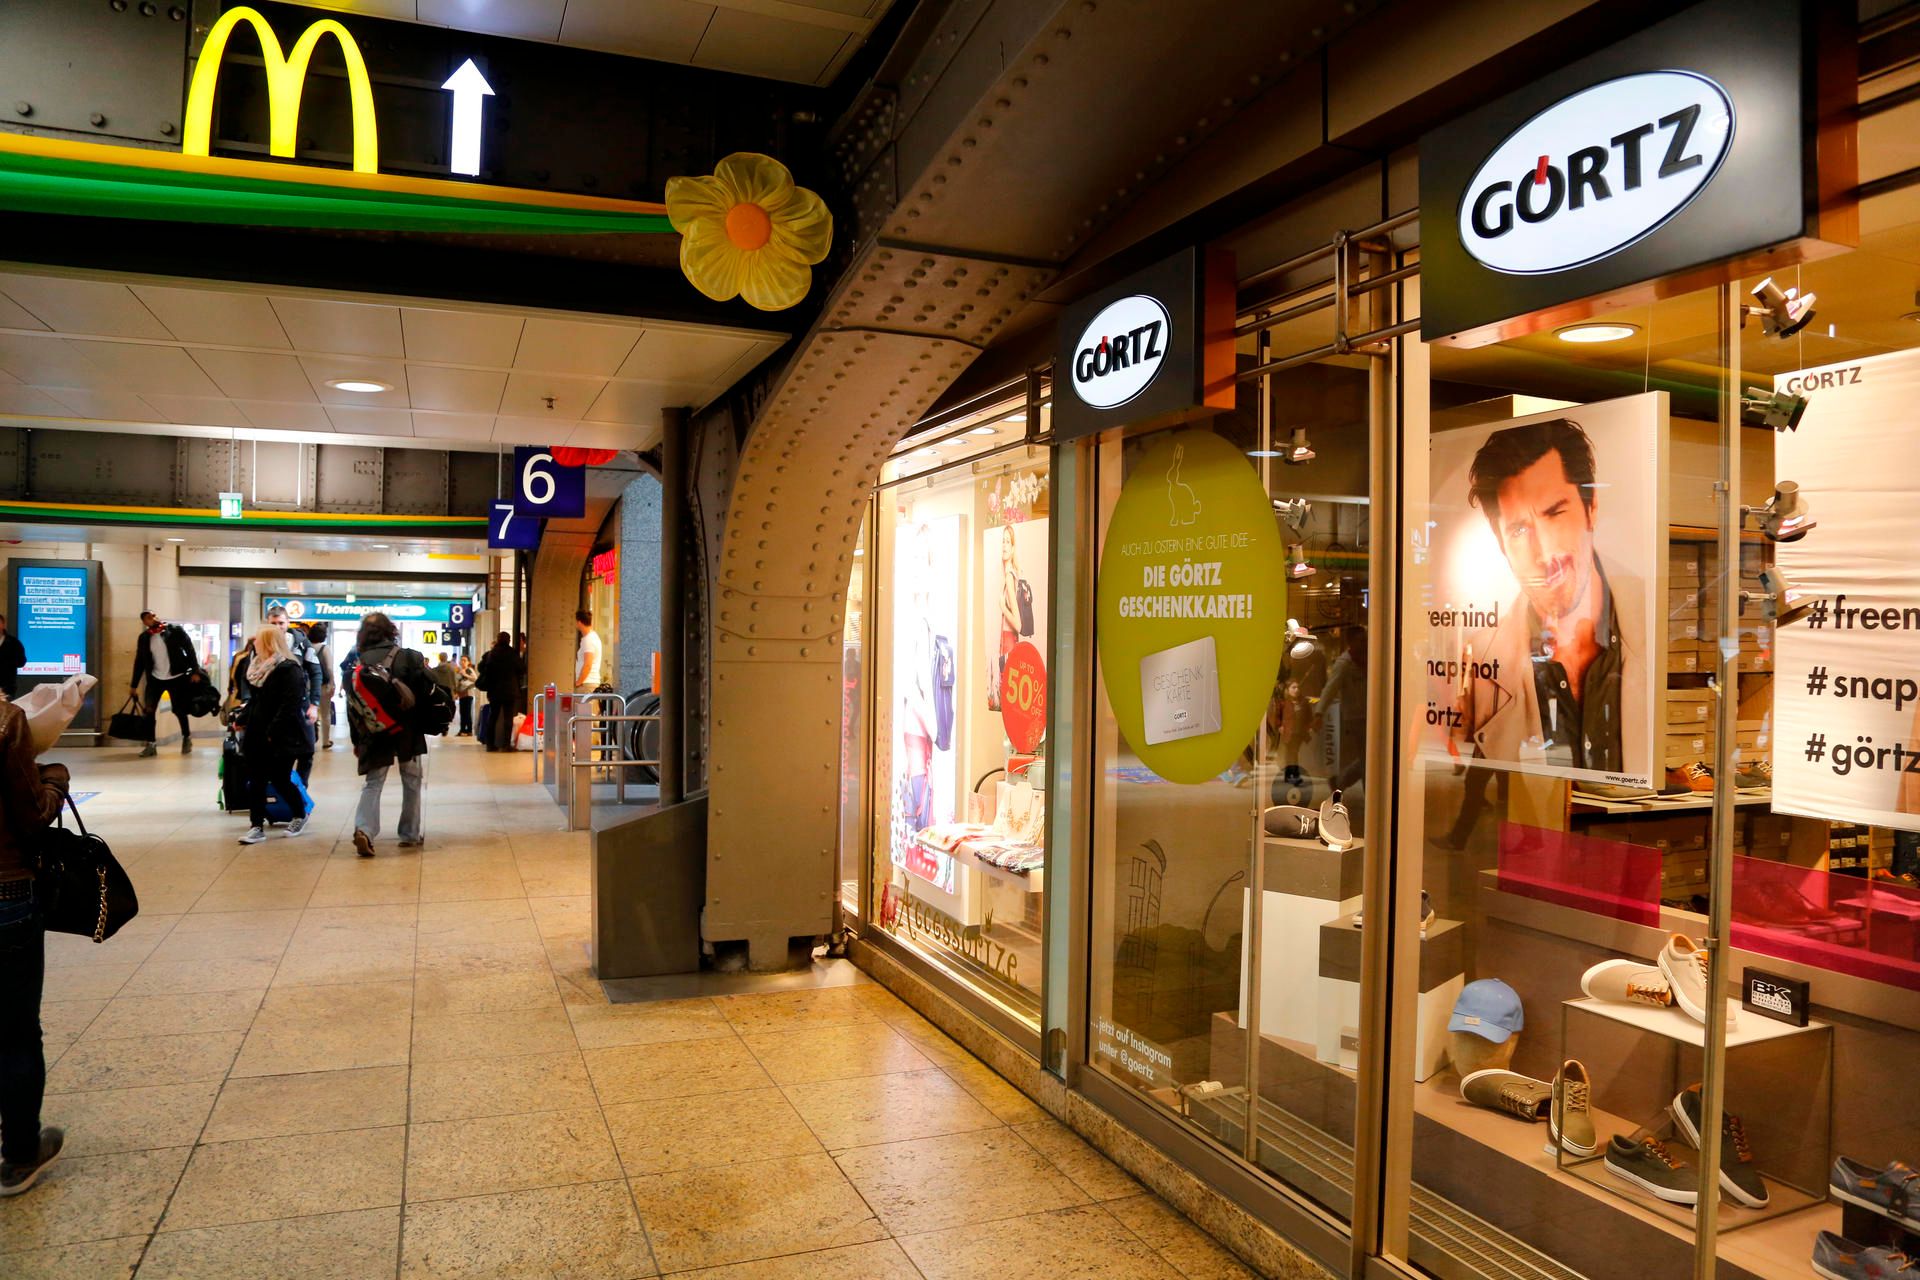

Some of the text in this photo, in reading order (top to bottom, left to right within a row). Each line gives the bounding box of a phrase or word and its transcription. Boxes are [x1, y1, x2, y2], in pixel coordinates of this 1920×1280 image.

[522, 453, 556, 504] 6
[494, 504, 515, 540] 7
[1121, 543, 1141, 556] AUCH
[1143, 541, 1153, 555] ZU
[1154, 539, 1184, 554] OSTERN
[1186, 536, 1203, 552] EINE
[1205, 534, 1228, 550] GUTE
[1143, 557, 1222, 588] DIE GÖRTZ
[451, 605, 464, 624] 8
[1119, 593, 1253, 619] GESCHENKKARTE!
[1427, 601, 1499, 628] eemind
[1020, 662, 1035, 674] UP TO
[1006, 667, 1043, 711] 50%
[1167, 684, 1191, 703] KARTE
[1807, 666, 1920, 711] #snap
[1030, 705, 1042, 716] OFF
[1605, 775, 1648, 785] www.goertz.de
[1098, 1039, 1154, 1080] unter @goertz
[1115, 1028, 1130, 1045] auf
[1130, 1032, 1172, 1069] Instagram
